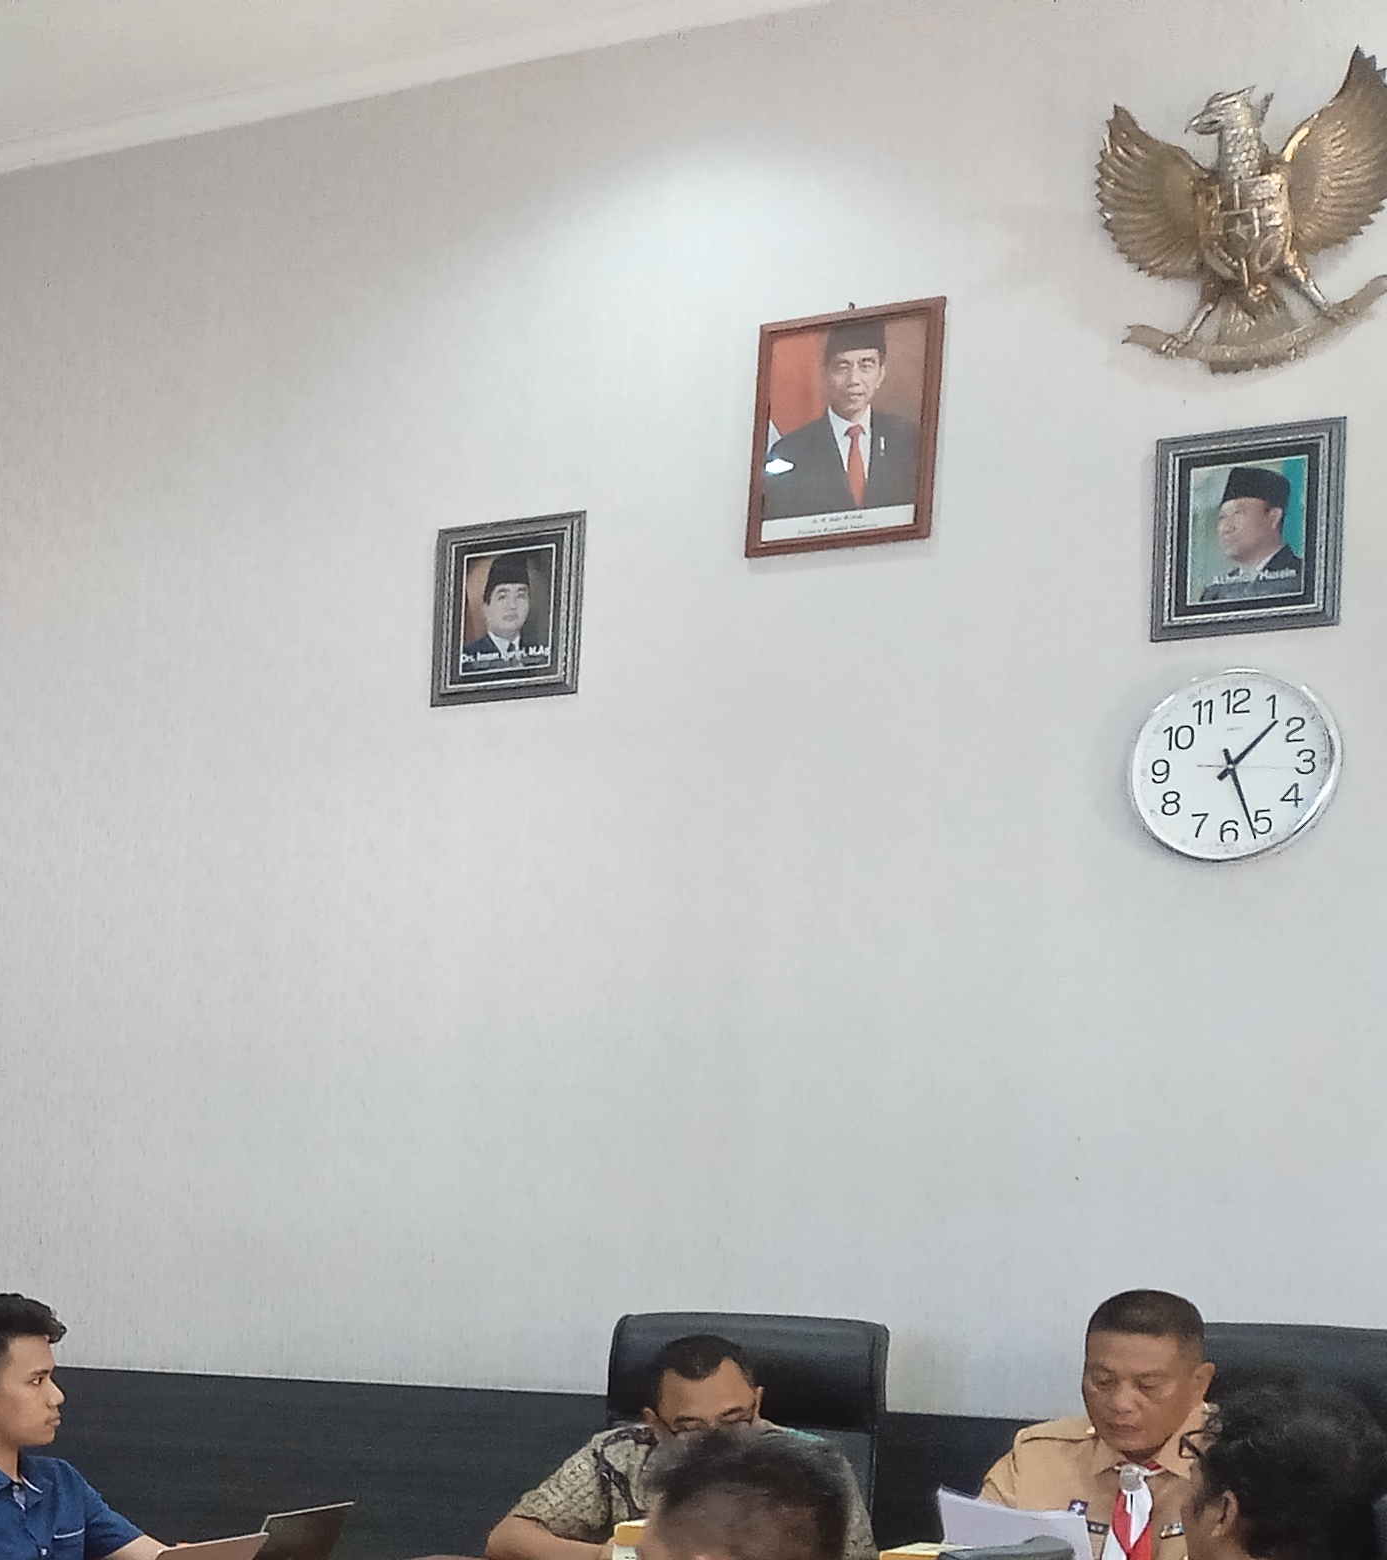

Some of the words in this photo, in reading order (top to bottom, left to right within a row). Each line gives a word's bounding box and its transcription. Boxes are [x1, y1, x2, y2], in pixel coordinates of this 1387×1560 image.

[1192, 700, 1214, 725] 11
[1221, 688, 1251, 714] 12
[1266, 694, 1277, 719] 1
[1163, 725, 1195, 750] 10
[1285, 717, 1306, 742] 2
[1151, 759, 1170, 784] 9
[1295, 749, 1316, 774] 3
[1161, 791, 1181, 816] 8
[1280, 782, 1304, 808] 4
[1191, 813, 1209, 838] 7
[1220, 820, 1239, 843] 6
[1253, 809, 1273, 835] 5
